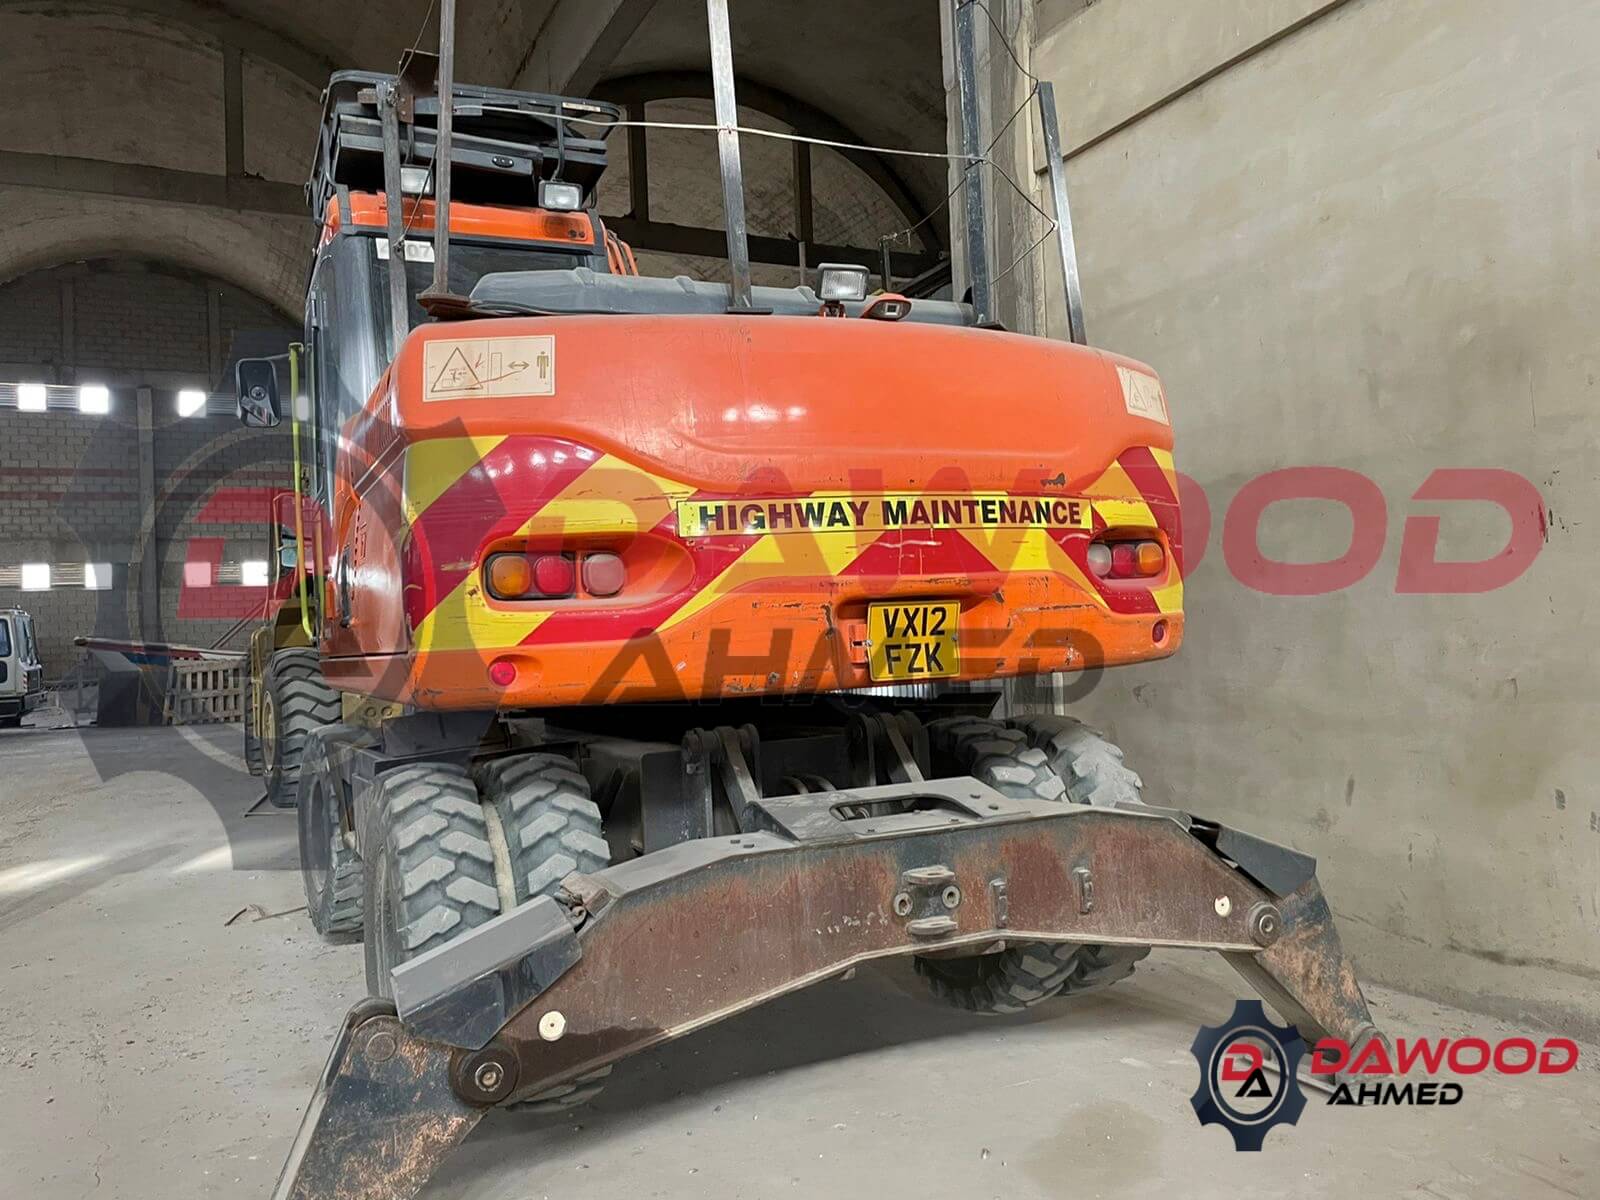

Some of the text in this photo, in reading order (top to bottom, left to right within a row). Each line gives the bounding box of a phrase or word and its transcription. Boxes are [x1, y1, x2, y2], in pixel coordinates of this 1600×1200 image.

[697, 499, 1082, 531] HIGHWAY MAINTENANCE
[883, 607, 947, 638] VX12
[885, 643, 944, 674] FZK
